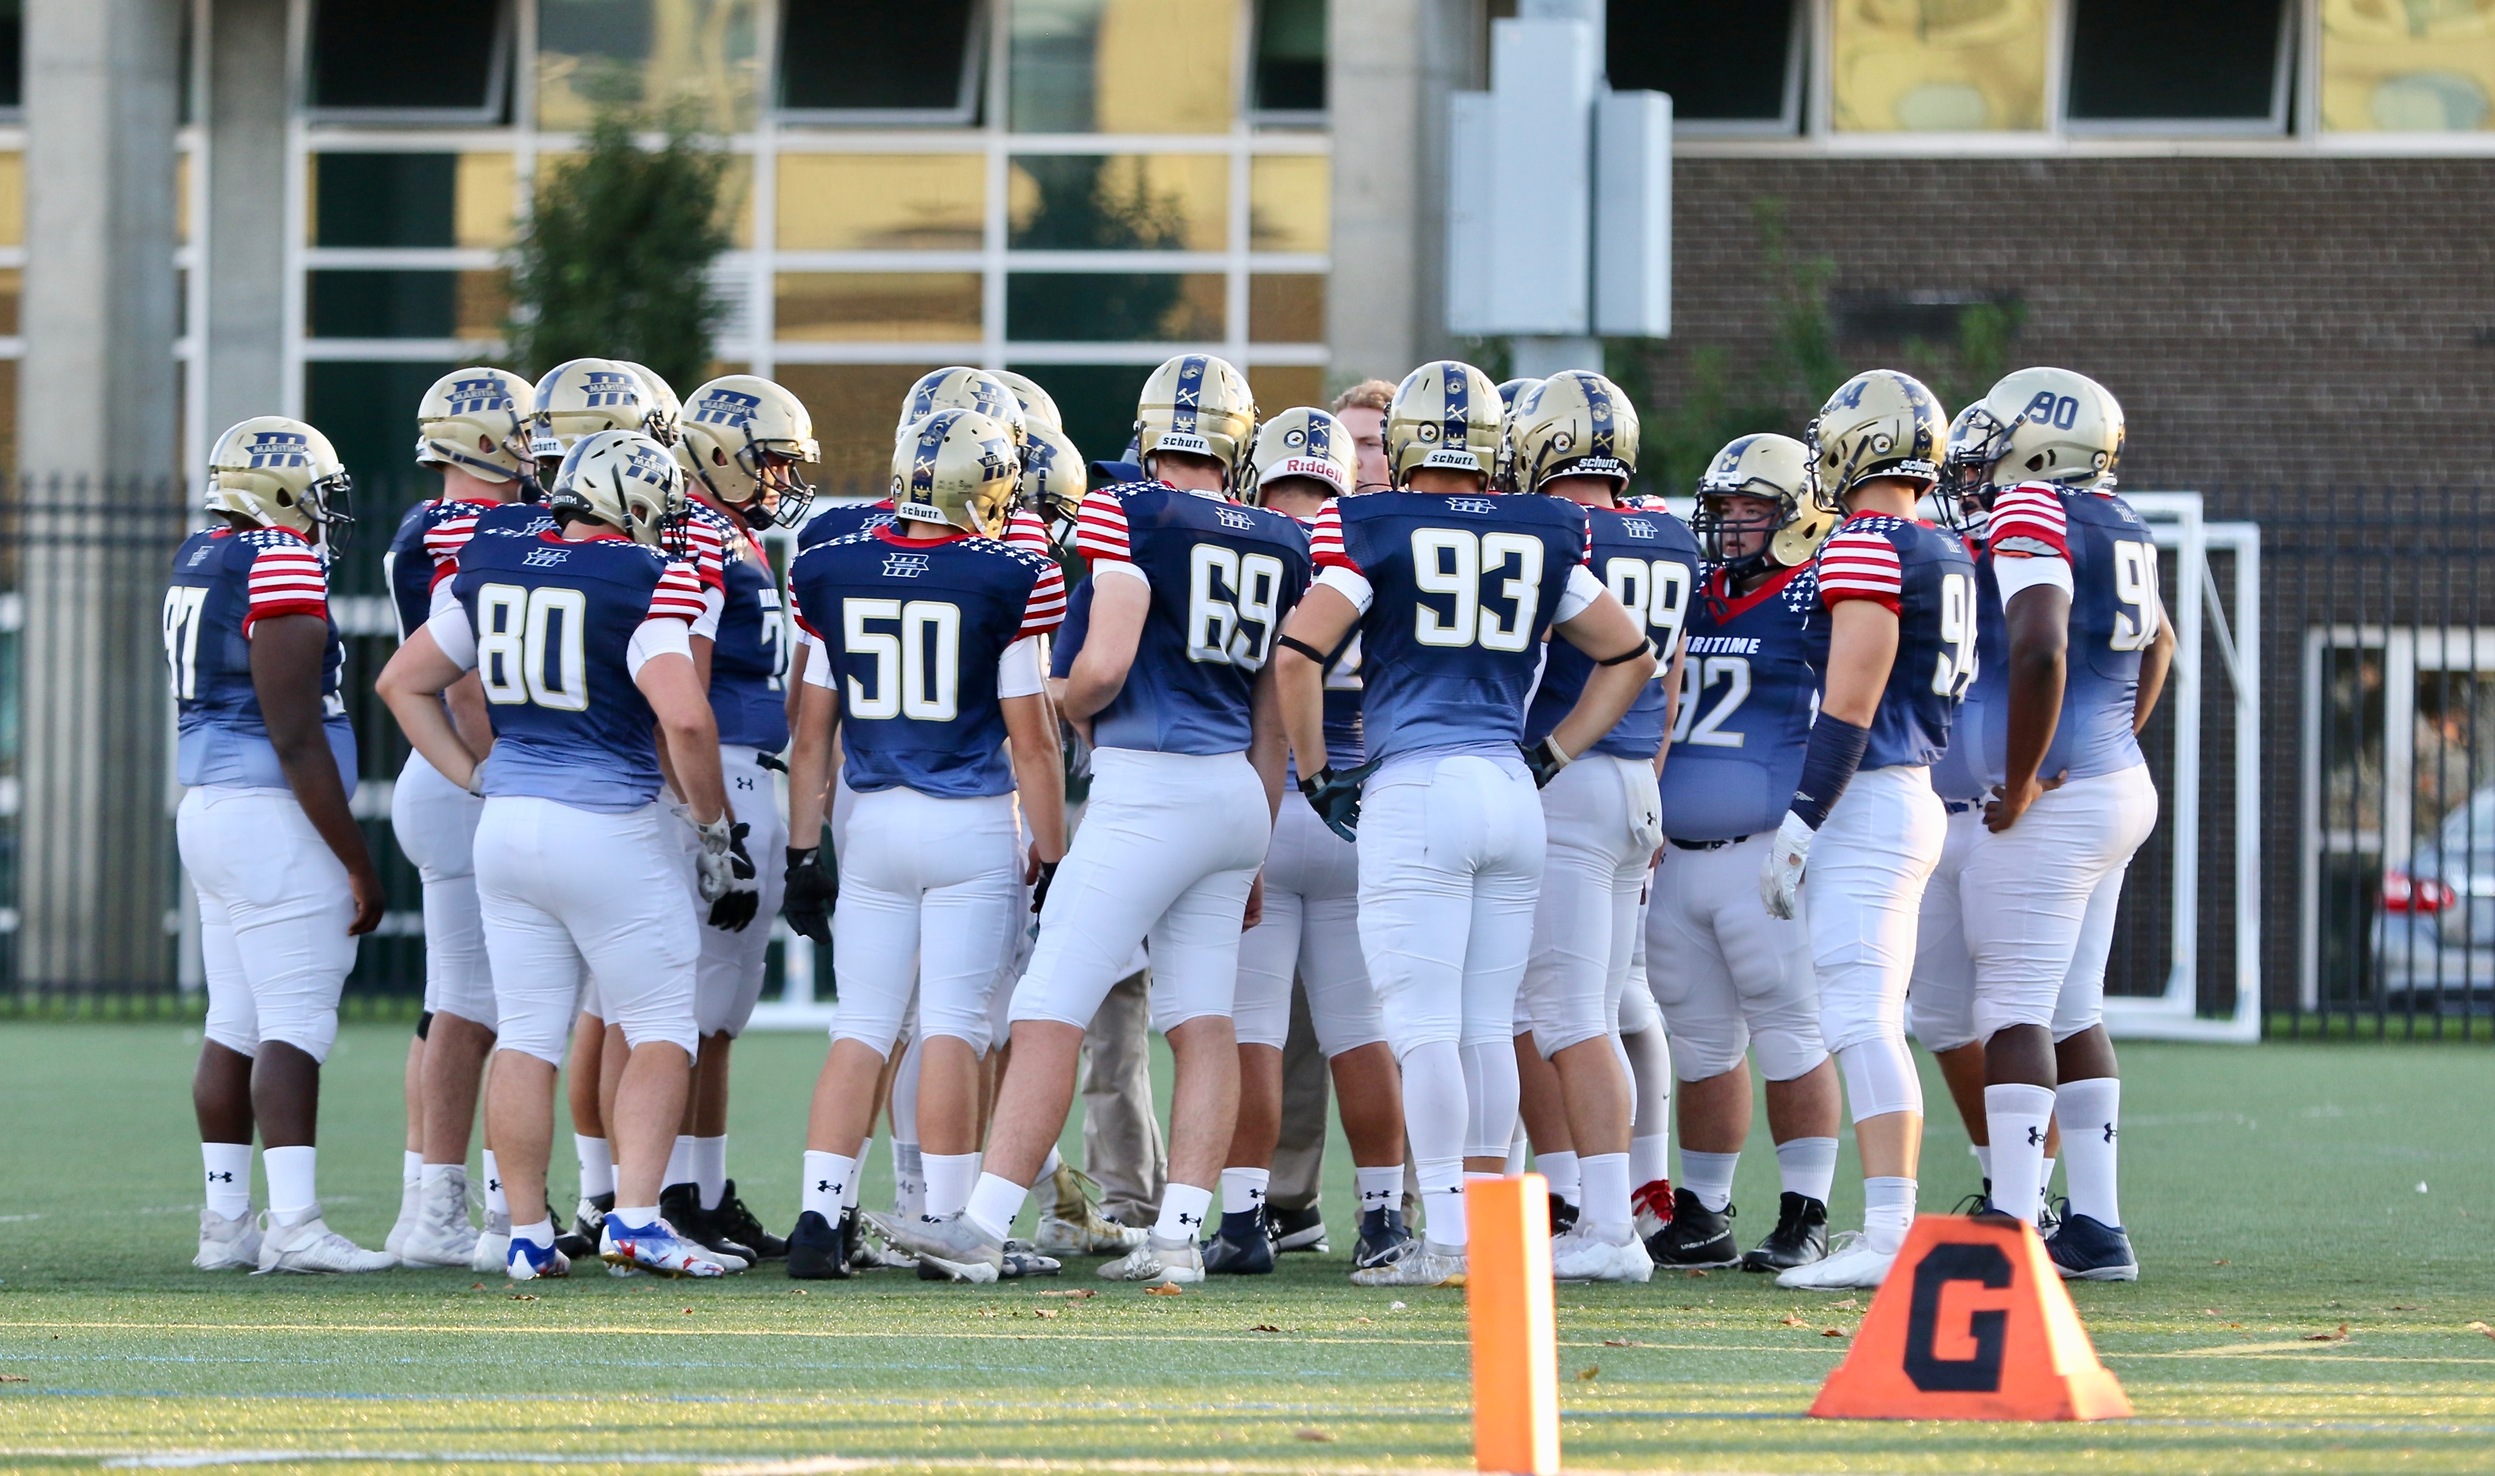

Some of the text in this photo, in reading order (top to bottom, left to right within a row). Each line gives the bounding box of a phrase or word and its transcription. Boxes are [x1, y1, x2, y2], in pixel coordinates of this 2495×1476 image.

[453, 389, 498, 401] MARITIM
[589, 383, 633, 393] MARITIM
[702, 401, 752, 417] MARITIME
[2030, 391, 2080, 431] 90
[1163, 436, 1204, 449] schutt
[1432, 454, 1474, 466] schutt
[1579, 455, 1620, 470] schutt
[1287, 459, 1343, 484] Riddell
[902, 506, 939, 519] schutt
[1411, 528, 1544, 652] 93
[1186, 543, 1284, 673] 69
[1606, 557, 1692, 680] 89
[478, 582, 589, 712] 80
[1686, 636, 1761, 655] RITIME
[843, 598, 961, 722] 50
[1123, 1259, 1161, 1280] adidas
[1903, 1243, 2014, 1392] G
